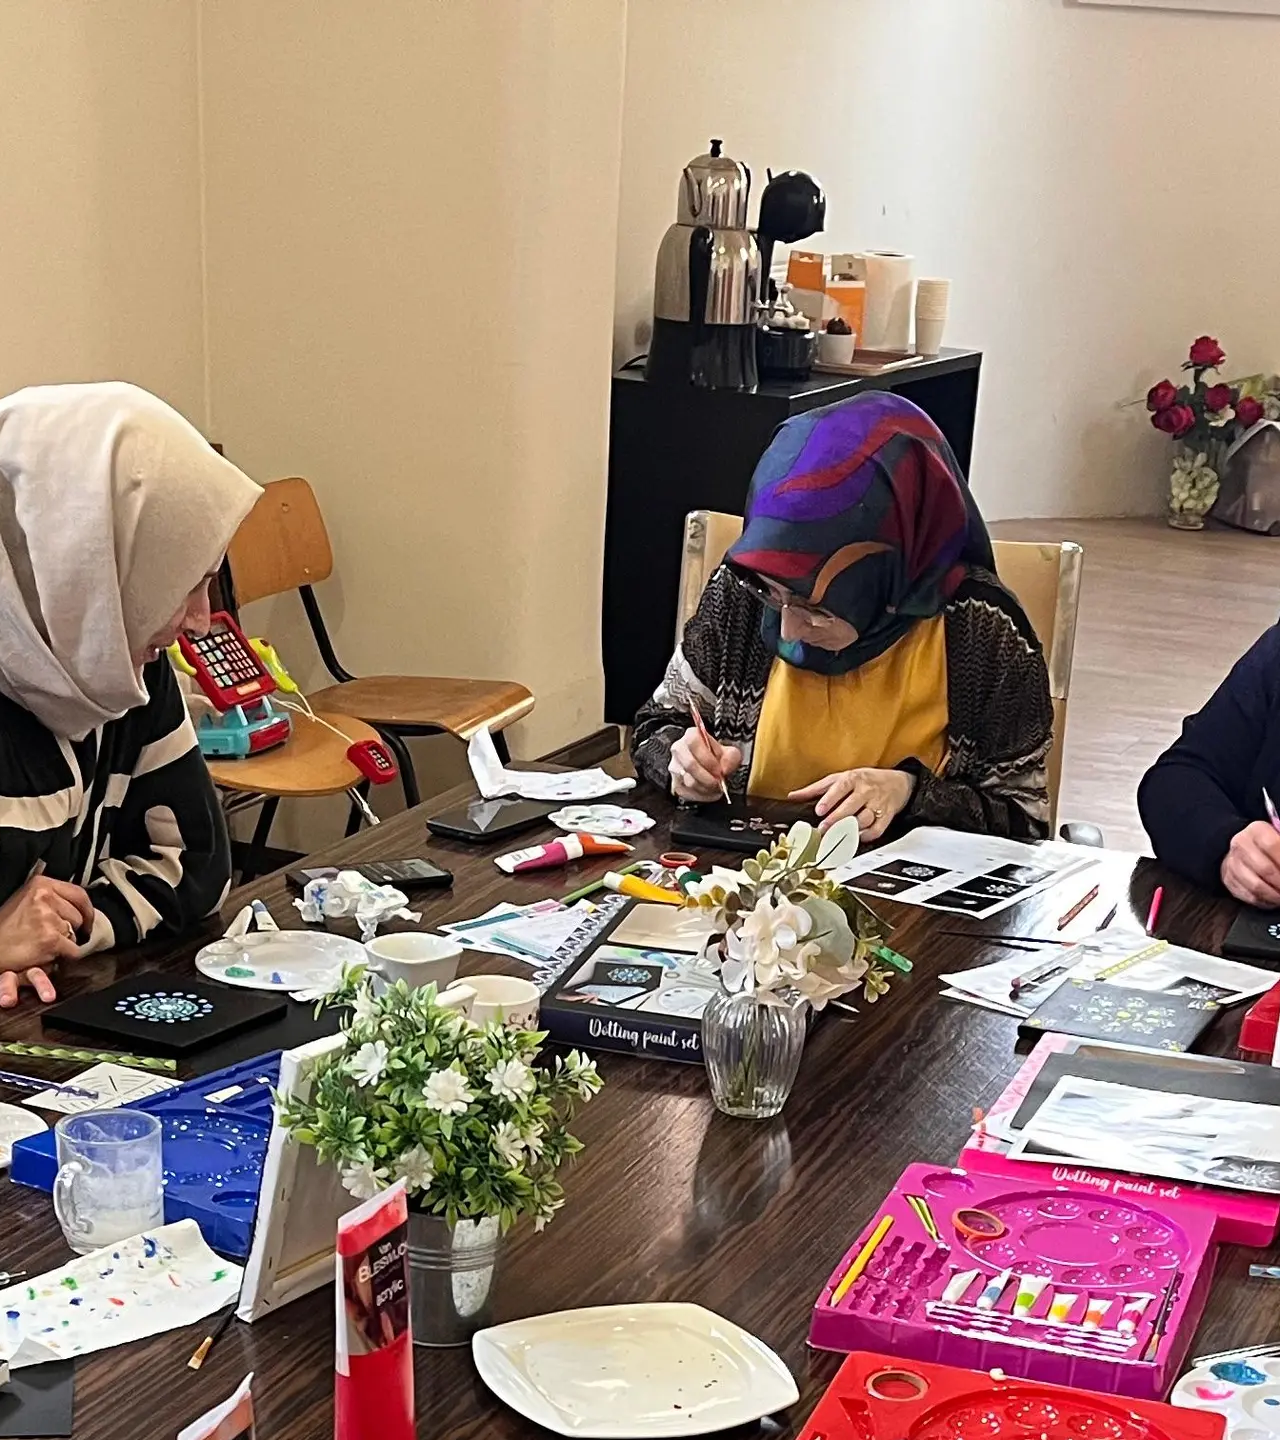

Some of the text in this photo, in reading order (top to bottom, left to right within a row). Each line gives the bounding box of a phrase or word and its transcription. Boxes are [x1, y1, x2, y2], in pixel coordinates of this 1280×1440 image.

[589, 1018, 700, 1050] Dotting paint set
[1052, 1167, 1181, 1199] Dotting paint set
